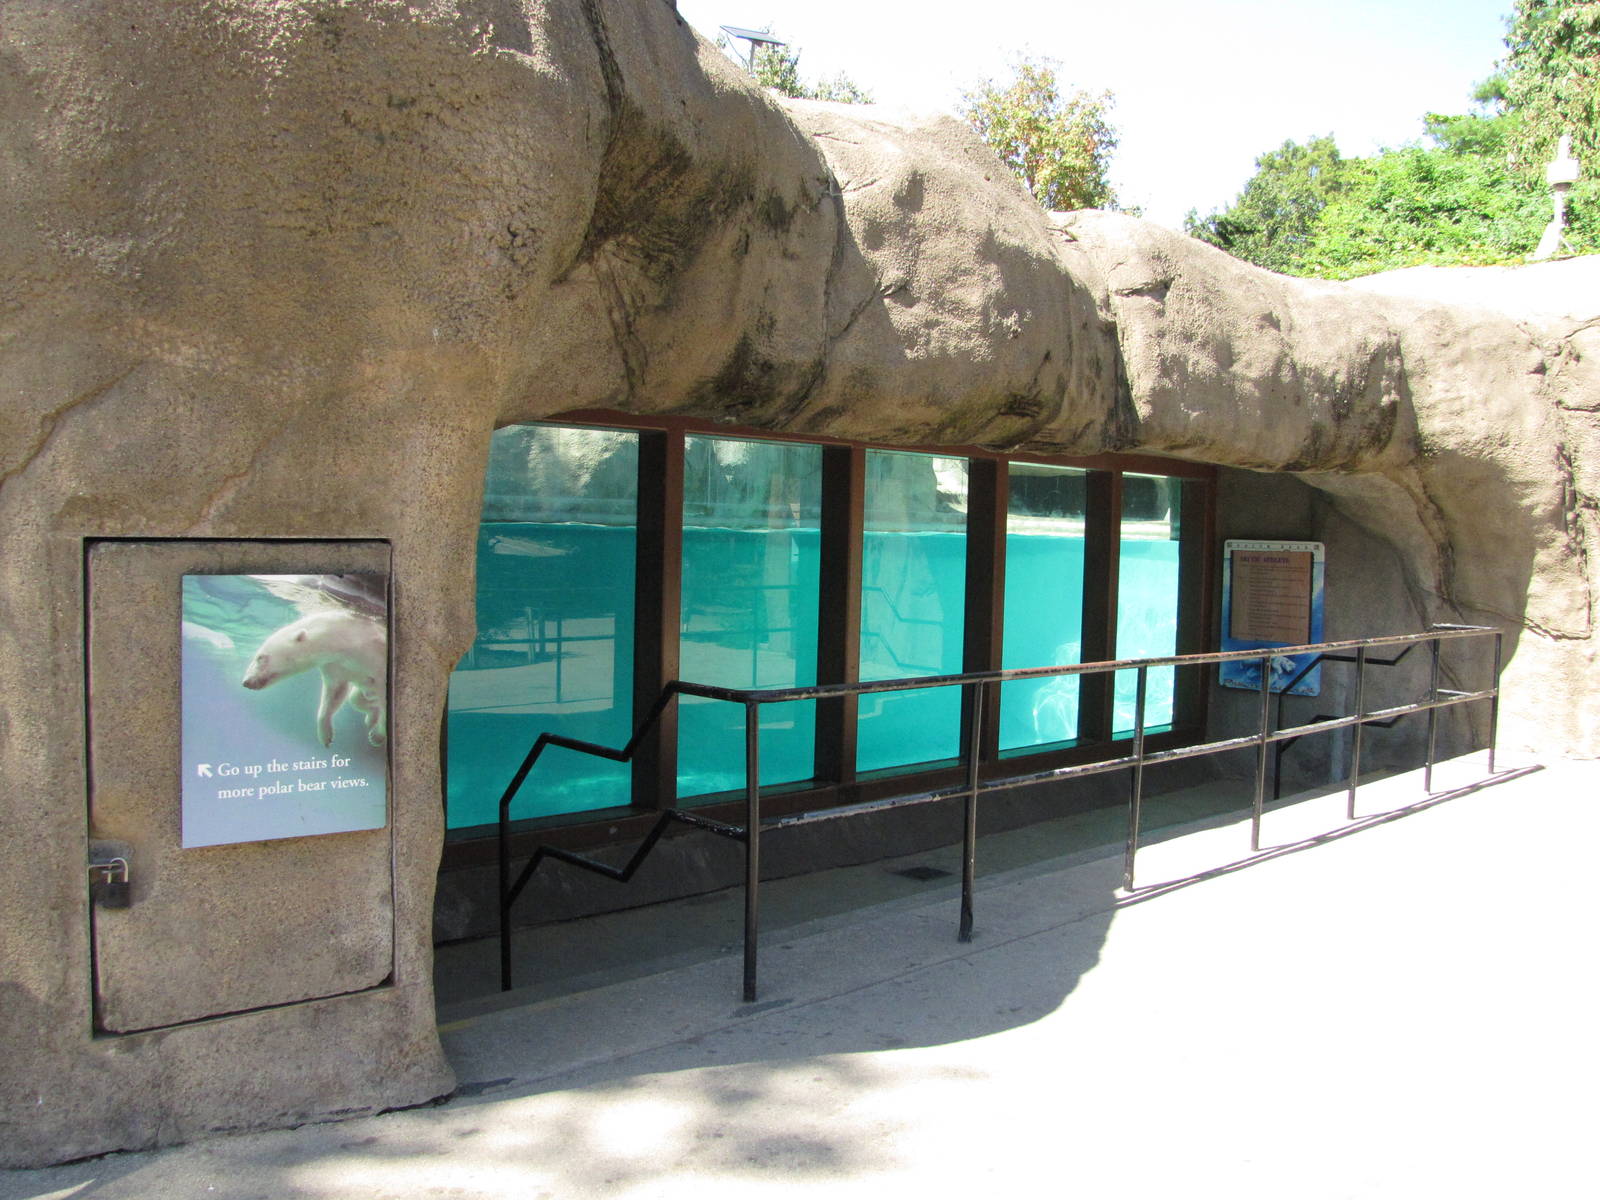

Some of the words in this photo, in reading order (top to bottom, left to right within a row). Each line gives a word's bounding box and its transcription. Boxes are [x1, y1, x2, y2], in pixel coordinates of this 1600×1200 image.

[218, 763, 240, 777] Go
[245, 764, 262, 778] up
[267, 759, 288, 773] the
[292, 756, 327, 771] stairs
[331, 754, 351, 768] for
[218, 786, 254, 799] more
[259, 781, 295, 799] polar
[298, 779, 327, 792] bear
[331, 776, 369, 789] views.
